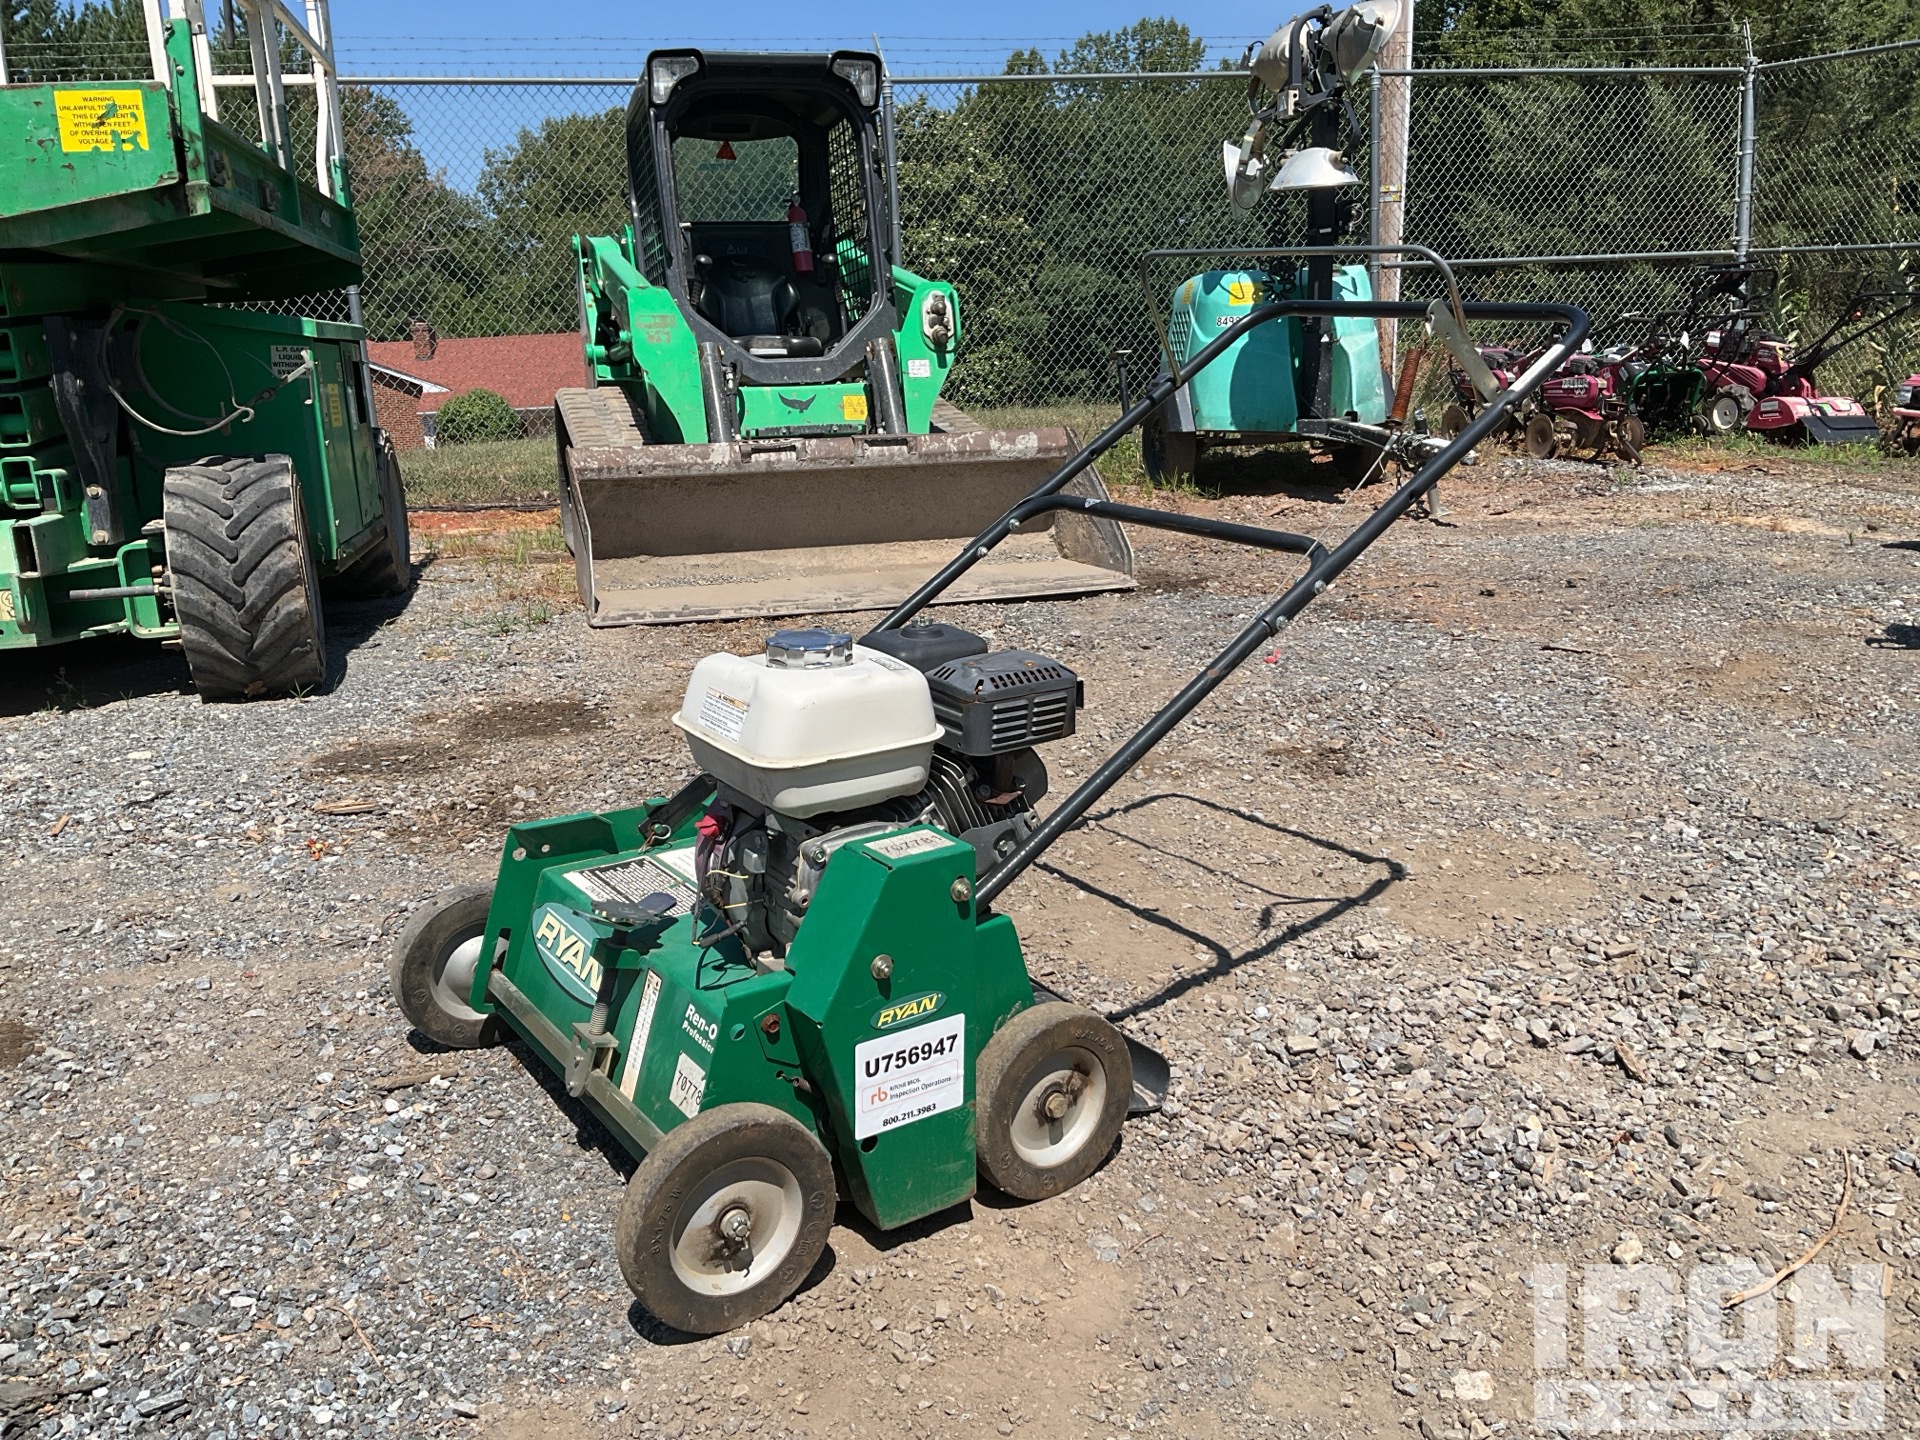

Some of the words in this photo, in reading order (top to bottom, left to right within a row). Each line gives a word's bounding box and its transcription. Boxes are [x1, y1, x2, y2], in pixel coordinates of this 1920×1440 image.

[536, 912, 604, 995] RYAN
[684, 1003, 718, 1040] Ren-O
[877, 993, 937, 1028] RYAN
[864, 1033, 959, 1079] U756947
[870, 1086, 889, 1106] rb
[889, 1081, 907, 1092] RITCHIE
[889, 1086, 920, 1100] Inspection
[920, 1076, 952, 1092] Operations
[882, 1103, 937, 1127] 800.211.3983
